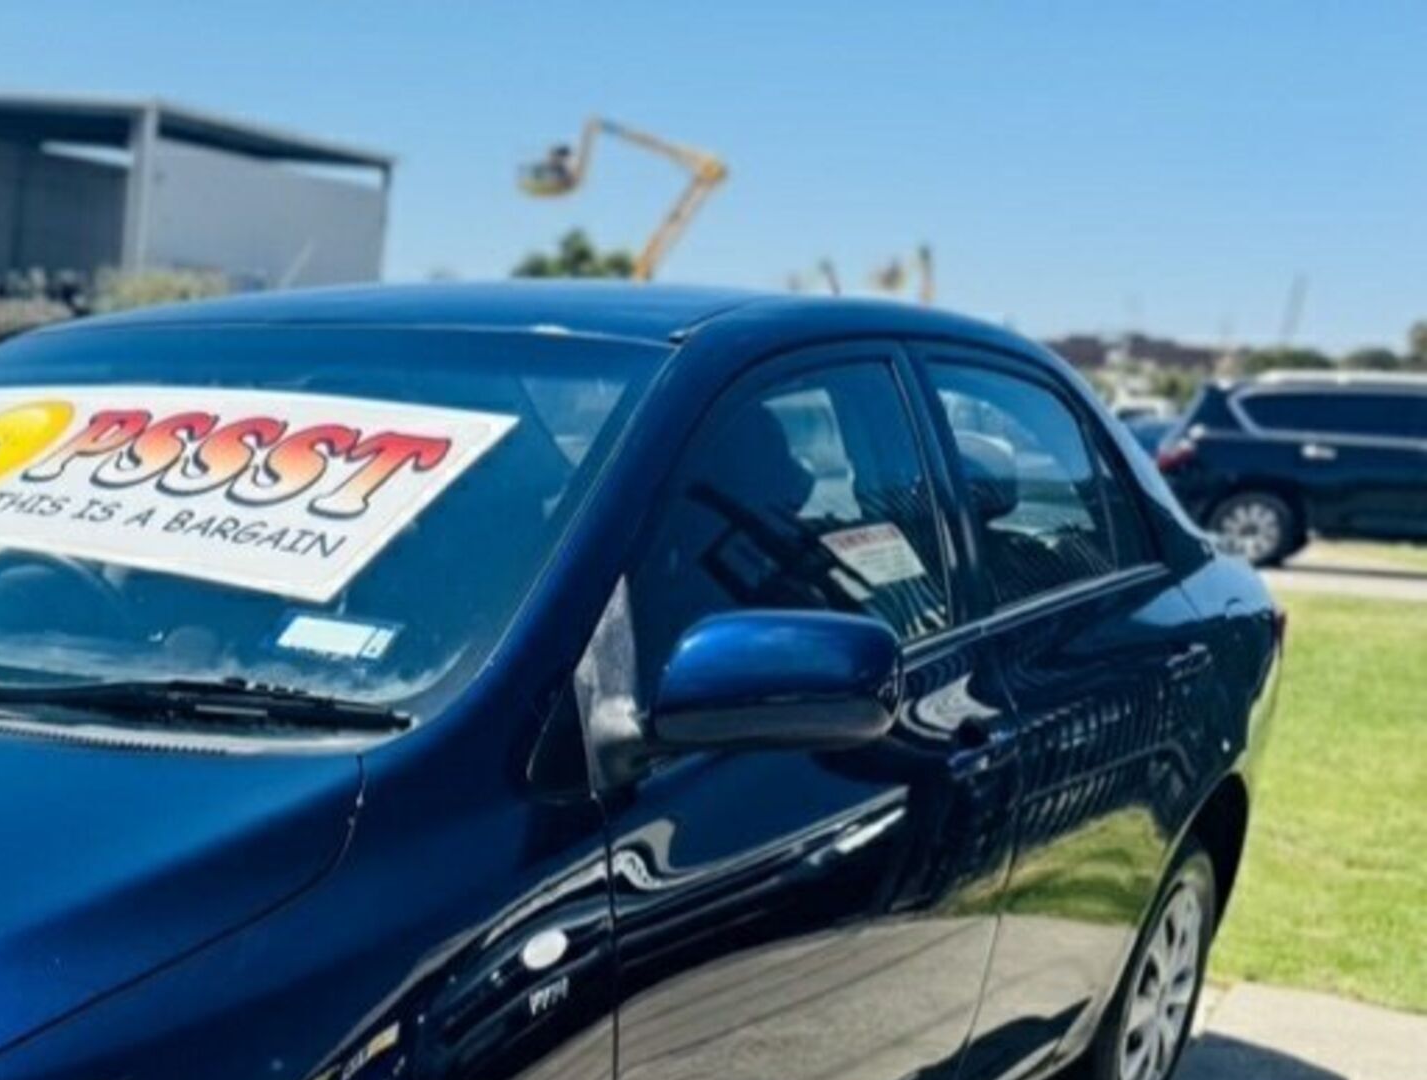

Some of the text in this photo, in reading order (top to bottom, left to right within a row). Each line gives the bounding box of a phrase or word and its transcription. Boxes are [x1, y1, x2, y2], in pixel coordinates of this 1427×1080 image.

[21, 409, 452, 519] PSSST
[71, 498, 122, 522] IS
[123, 507, 156, 527] A
[162, 508, 347, 559] BARGAIN
